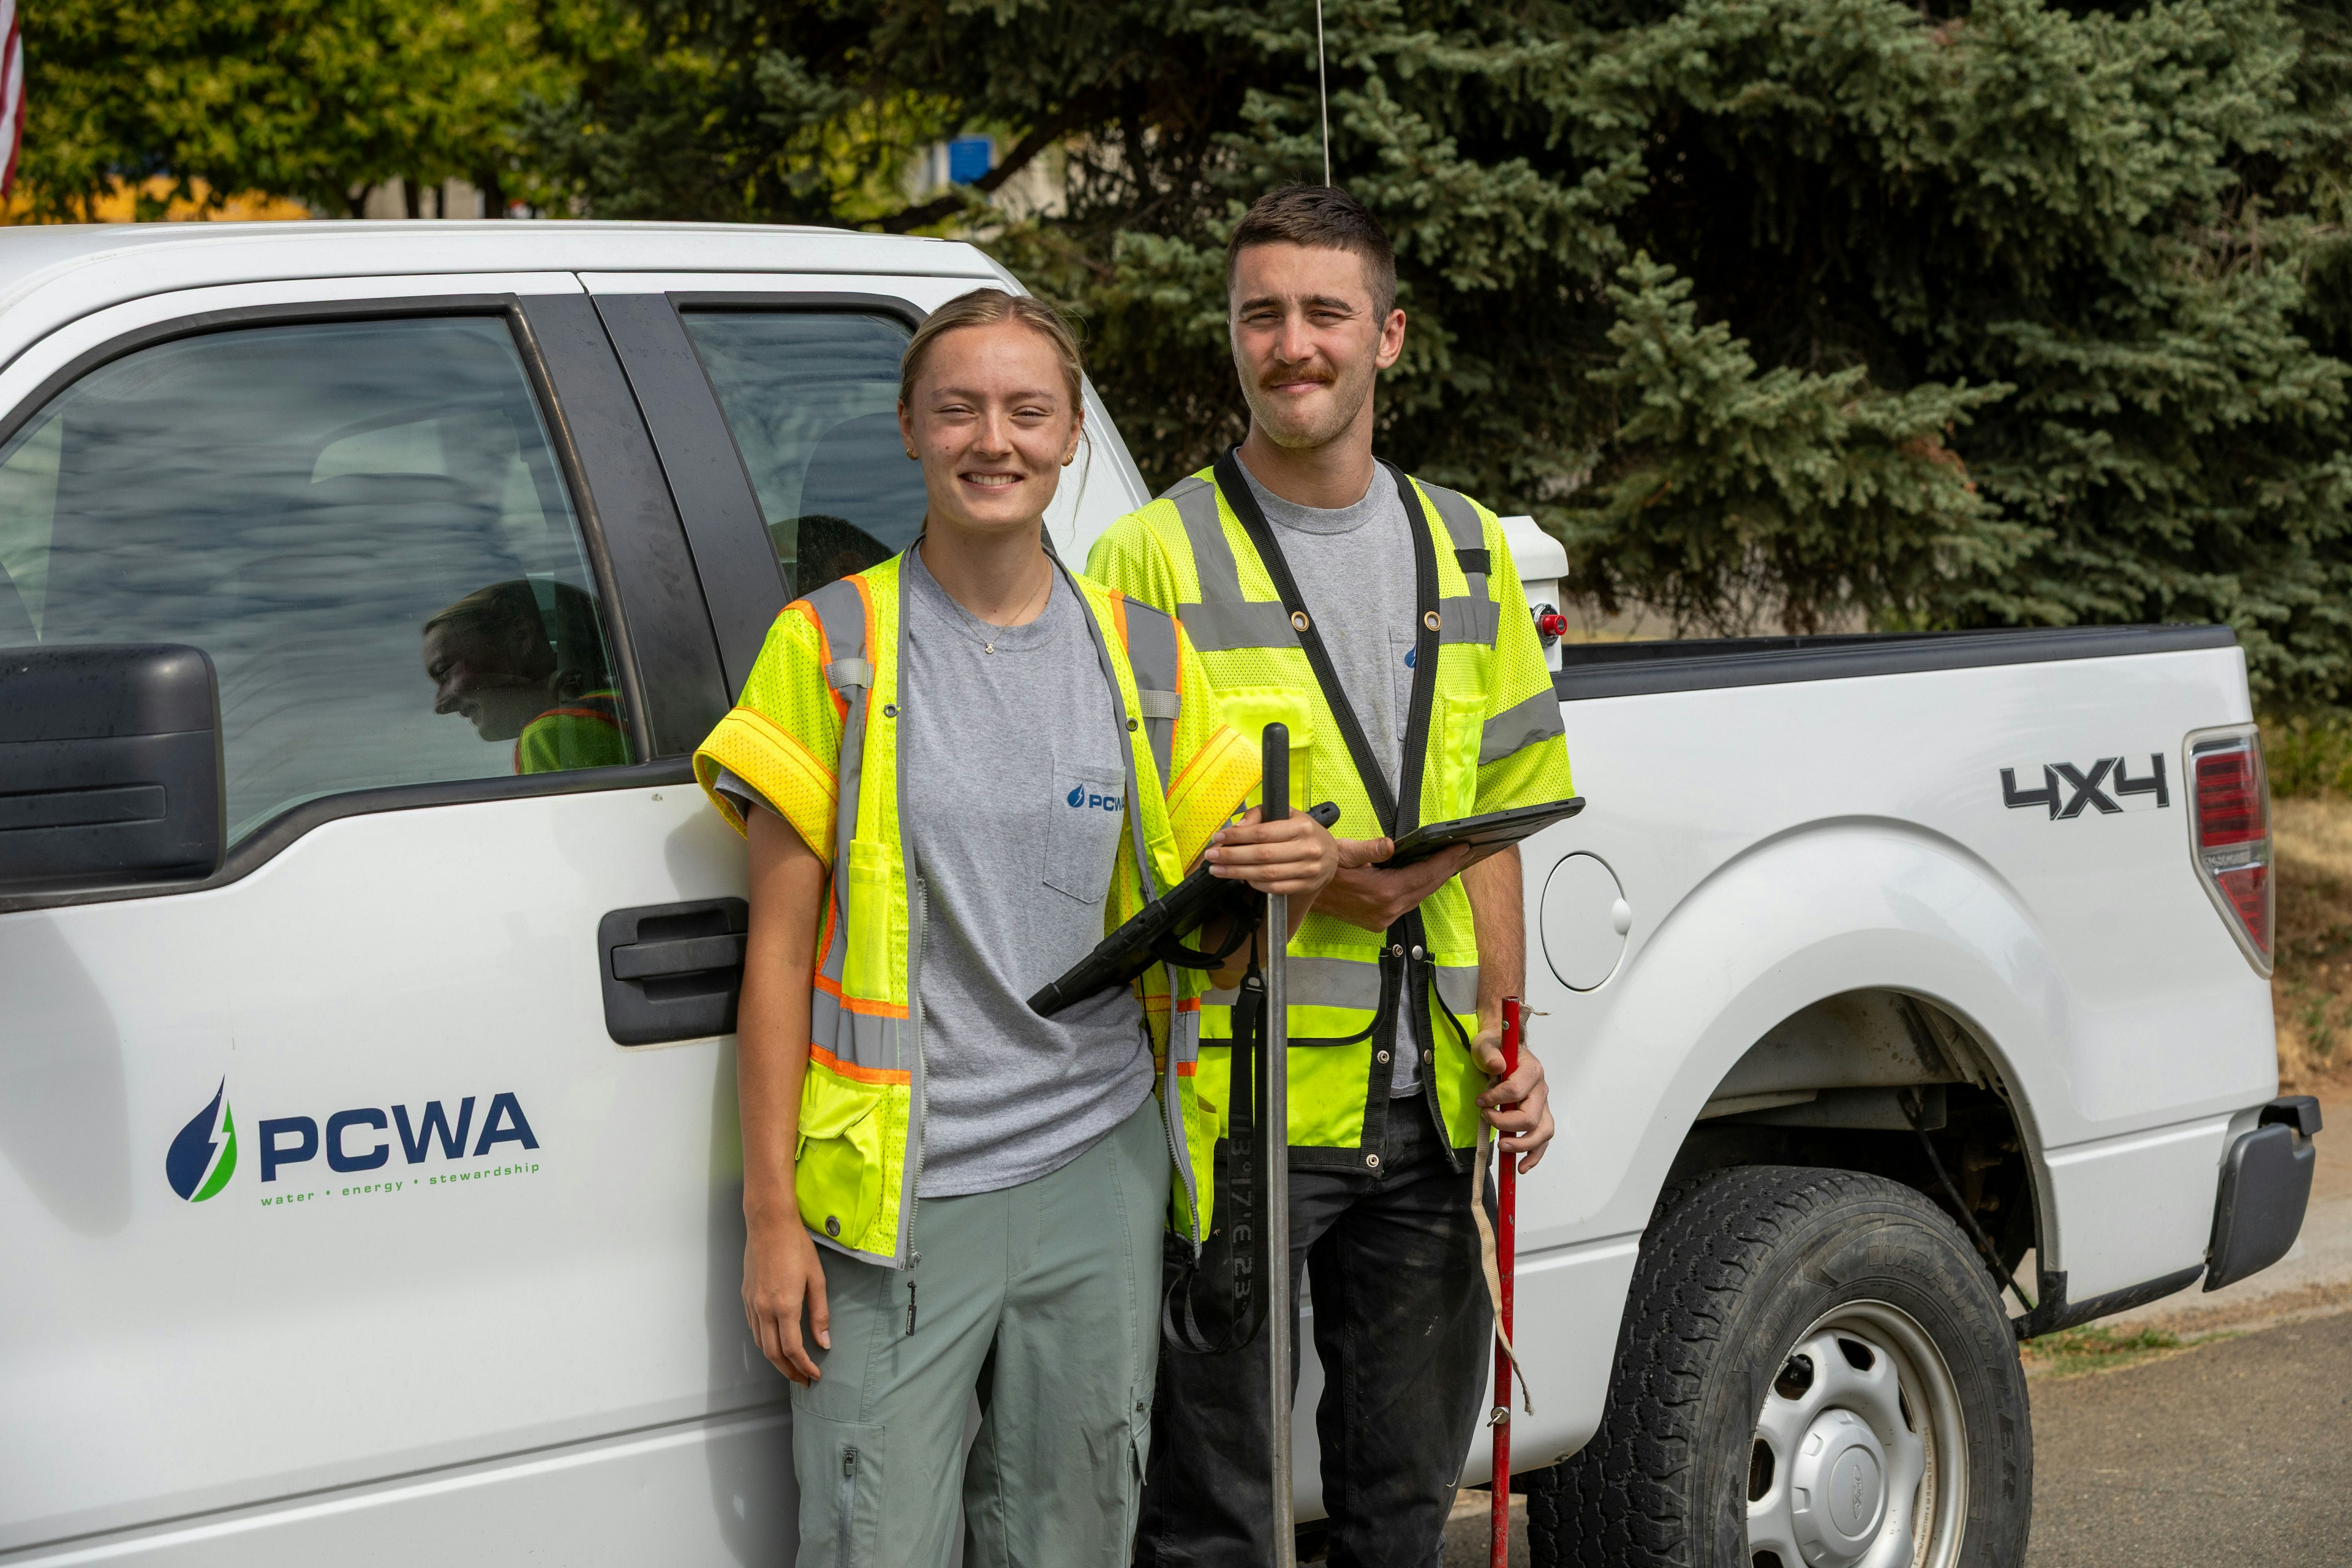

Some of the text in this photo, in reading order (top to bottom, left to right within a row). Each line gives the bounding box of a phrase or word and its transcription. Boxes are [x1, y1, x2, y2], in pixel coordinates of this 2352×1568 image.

[2000, 753, 2169, 820] 4X4
[258, 1092, 540, 1183] PCWA
[261, 1163, 540, 1206] water energy stewardship
[1867, 1244, 2016, 1504] WRANGLER
